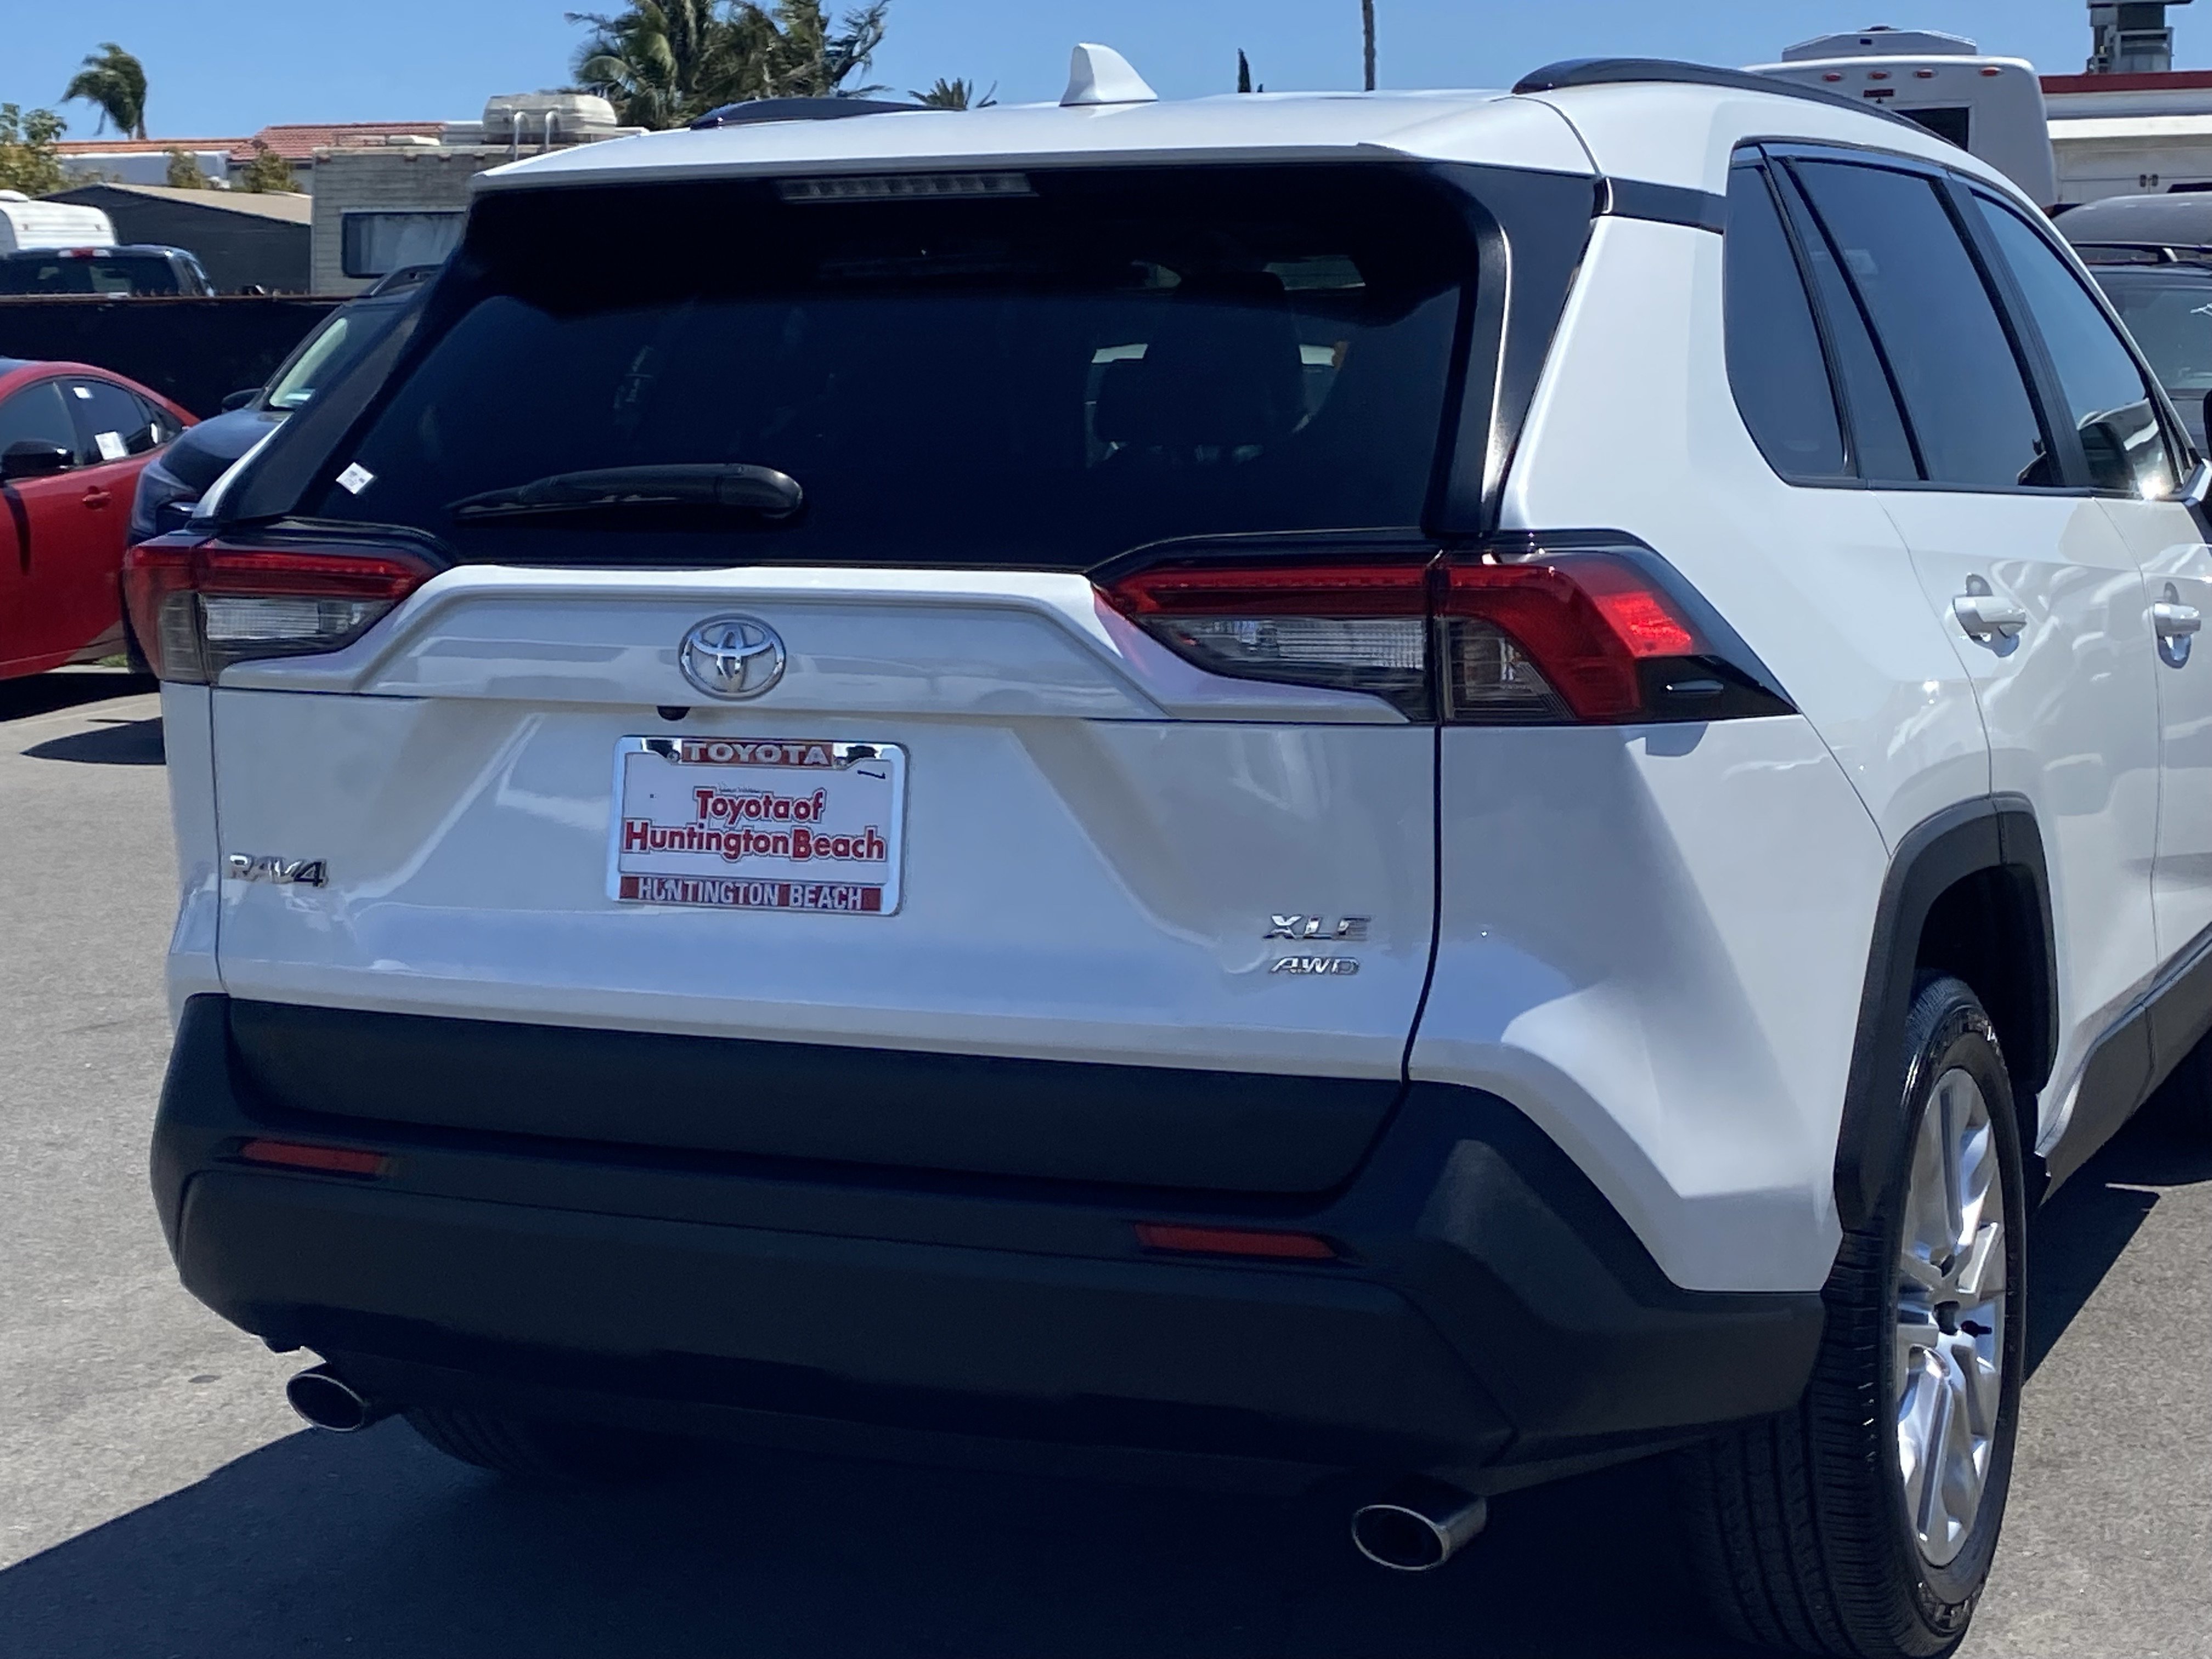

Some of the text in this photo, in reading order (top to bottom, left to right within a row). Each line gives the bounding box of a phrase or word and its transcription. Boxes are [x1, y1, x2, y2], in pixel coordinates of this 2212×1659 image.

[685, 742, 831, 766] TOYOTA
[696, 790, 825, 824] Toyota of
[624, 821, 884, 860] Huntington Beach
[229, 853, 329, 888] RAV4
[638, 877, 862, 911] HUNTINGTON BEACH
[1263, 915, 1370, 940] XLE
[1269, 956, 1361, 975] AWD
